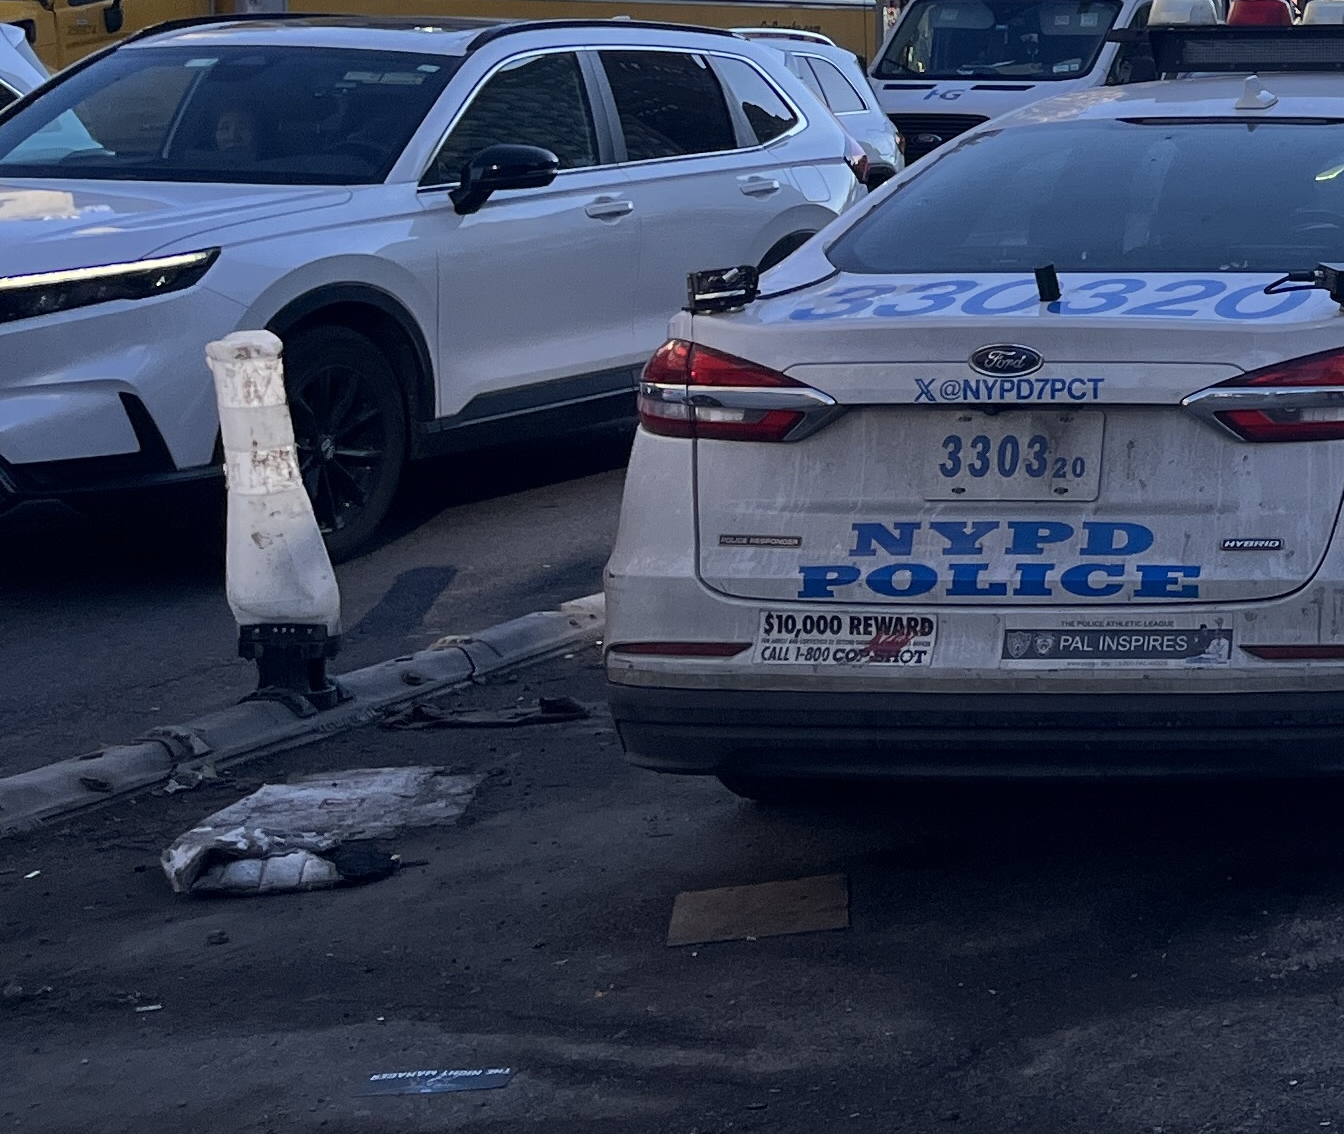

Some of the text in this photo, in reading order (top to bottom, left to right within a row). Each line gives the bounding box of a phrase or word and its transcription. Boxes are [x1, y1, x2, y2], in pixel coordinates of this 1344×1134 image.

[983, 349, 1026, 368] Ford
[939, 377, 1105, 401] @NYPD7PCT
[938, 433, 1086, 479] 3303 20
[848, 520, 1155, 557] NYPD
[1222, 537, 1283, 550] HYBRID
[796, 563, 1202, 599] POLICE
[763, 611, 934, 638] $10,000 REWARD
[1060, 620, 1175, 628] THE POLICE ATHLETIC LEAGUE
[1058, 635, 1189, 653] PAL INSPIRES
[761, 645, 790, 662] CALL
[794, 646, 831, 663] 1-800
[369, 1070, 438, 1081] MANAGER
